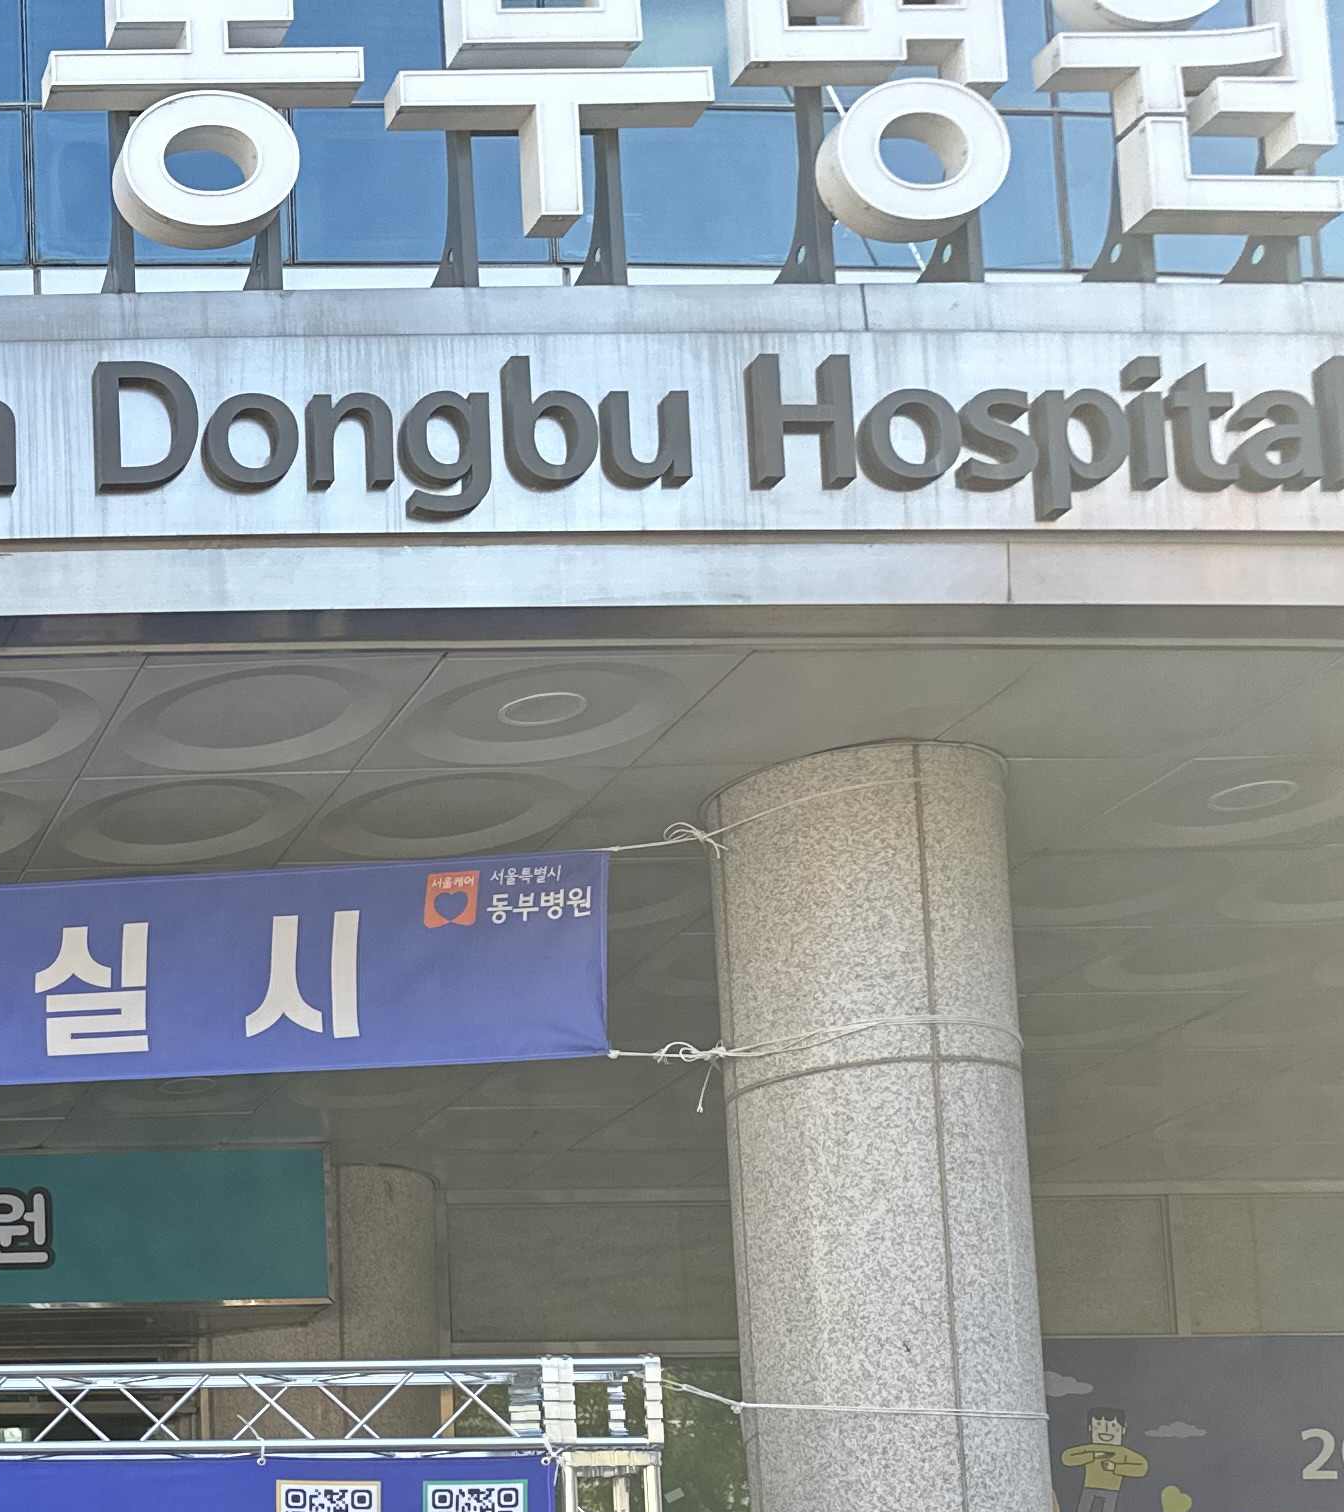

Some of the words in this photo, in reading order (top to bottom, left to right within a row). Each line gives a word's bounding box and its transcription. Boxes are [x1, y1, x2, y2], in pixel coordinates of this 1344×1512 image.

[91, 354, 693, 521] Dongbu
[430, 876, 475, 890] 서울케어
[489, 864, 562, 886] 서울특별시
[486, 885, 592, 924] 동부병원
[1300, 1427, 1344, 1480] 2
